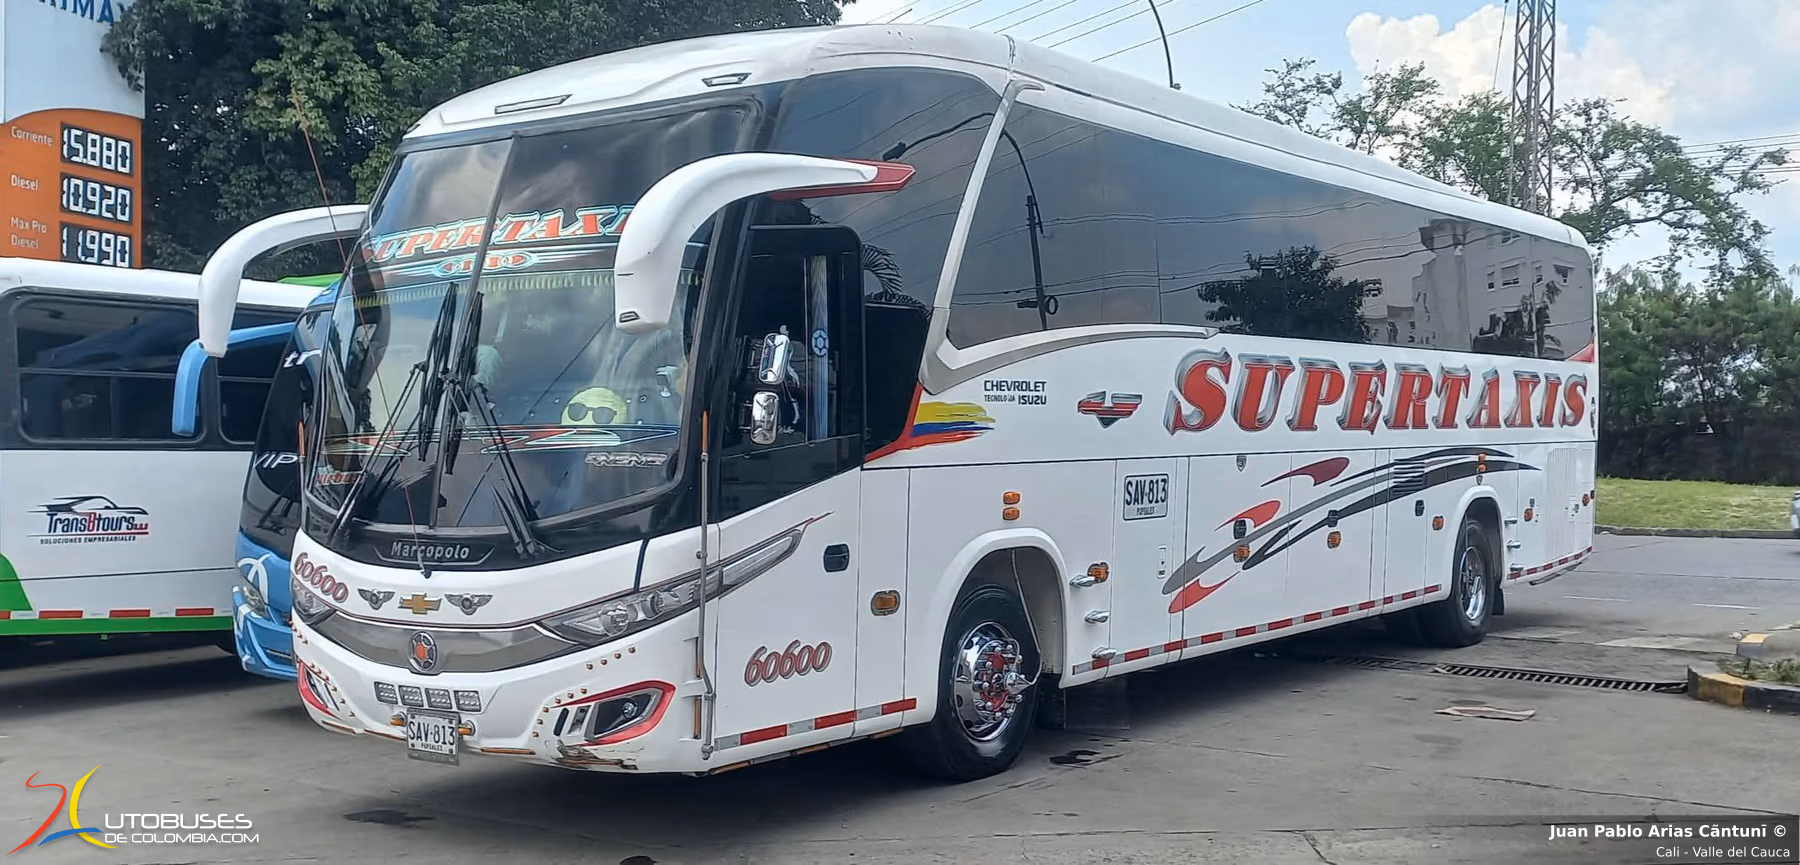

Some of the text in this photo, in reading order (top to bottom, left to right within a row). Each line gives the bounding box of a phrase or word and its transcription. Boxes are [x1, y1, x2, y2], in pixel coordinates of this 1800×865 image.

[11, 125, 131, 173] Corriente 15.880
[11, 175, 131, 222] Diesel 10.920
[11, 216, 47, 233] Max Pro
[11, 234, 39, 250] Diesel
[984, 380, 1047, 392] CHEVROLET
[1163, 347, 1587, 436] SUPERTAXIS
[1018, 395, 1047, 405] ISUZU
[253, 452, 299, 469] VIP
[84, 535, 137, 543] EMPRESARIALES
[391, 541, 470, 560] Marcopolo
[294, 552, 349, 603] 60600
[744, 639, 832, 687] 60600
